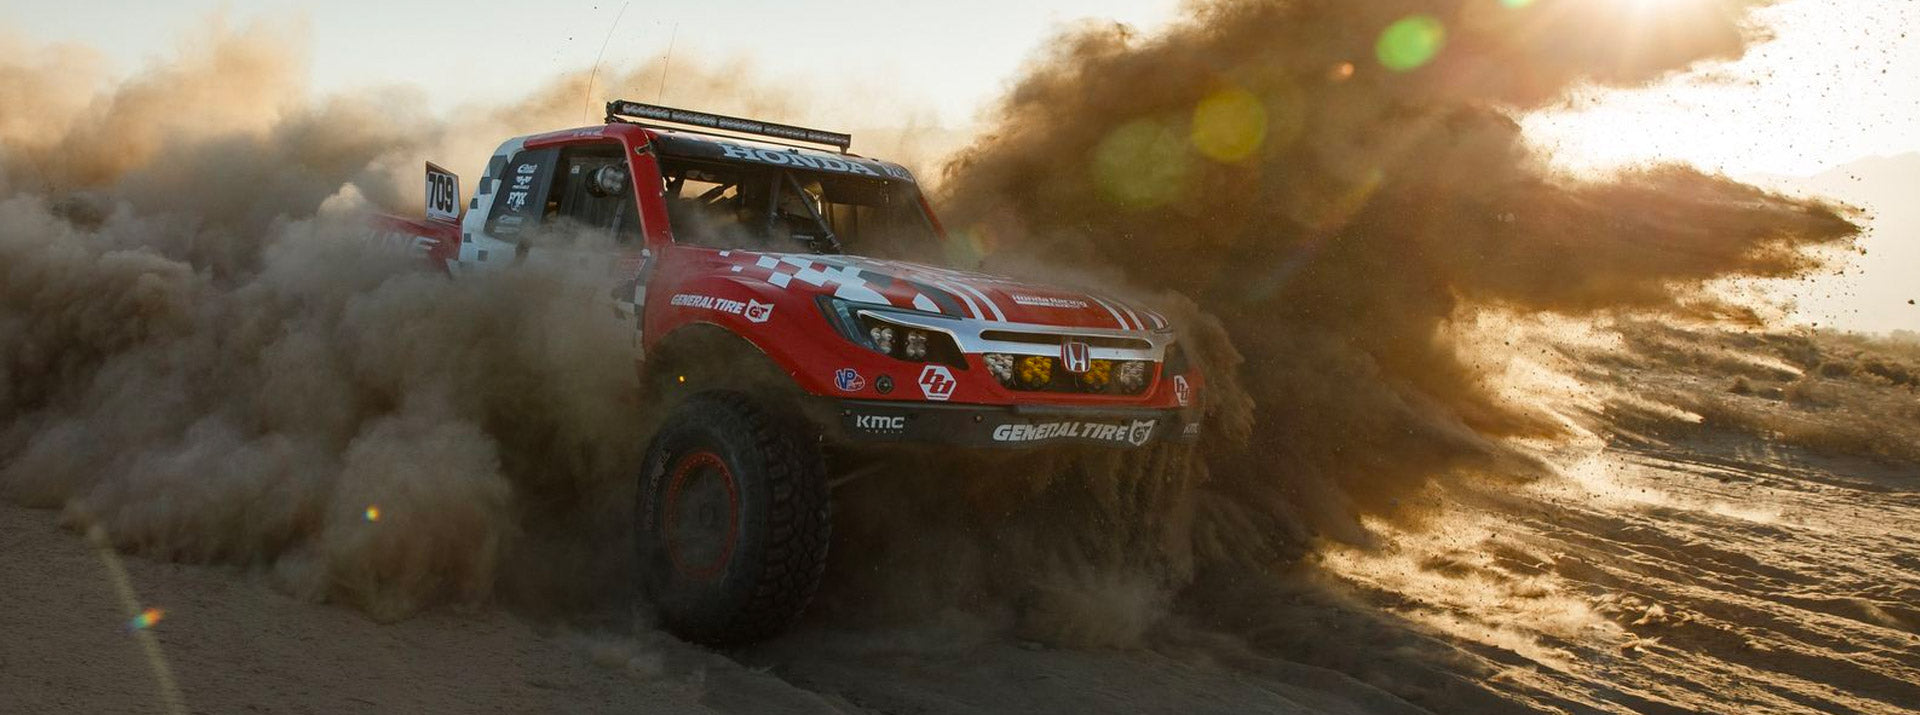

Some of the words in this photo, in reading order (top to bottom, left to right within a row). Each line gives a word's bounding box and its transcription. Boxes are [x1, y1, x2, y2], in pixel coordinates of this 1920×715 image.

[719, 144, 881, 177] HONDA
[428, 173, 454, 213] 709
[670, 294, 716, 309] GENERAL
[714, 298, 745, 314] TIRE
[1012, 294, 1049, 303] Honda
[836, 369, 855, 390] VP
[856, 414, 904, 429] KMC
[993, 422, 1081, 442] GENERAL
[1079, 423, 1130, 442] TIRE
